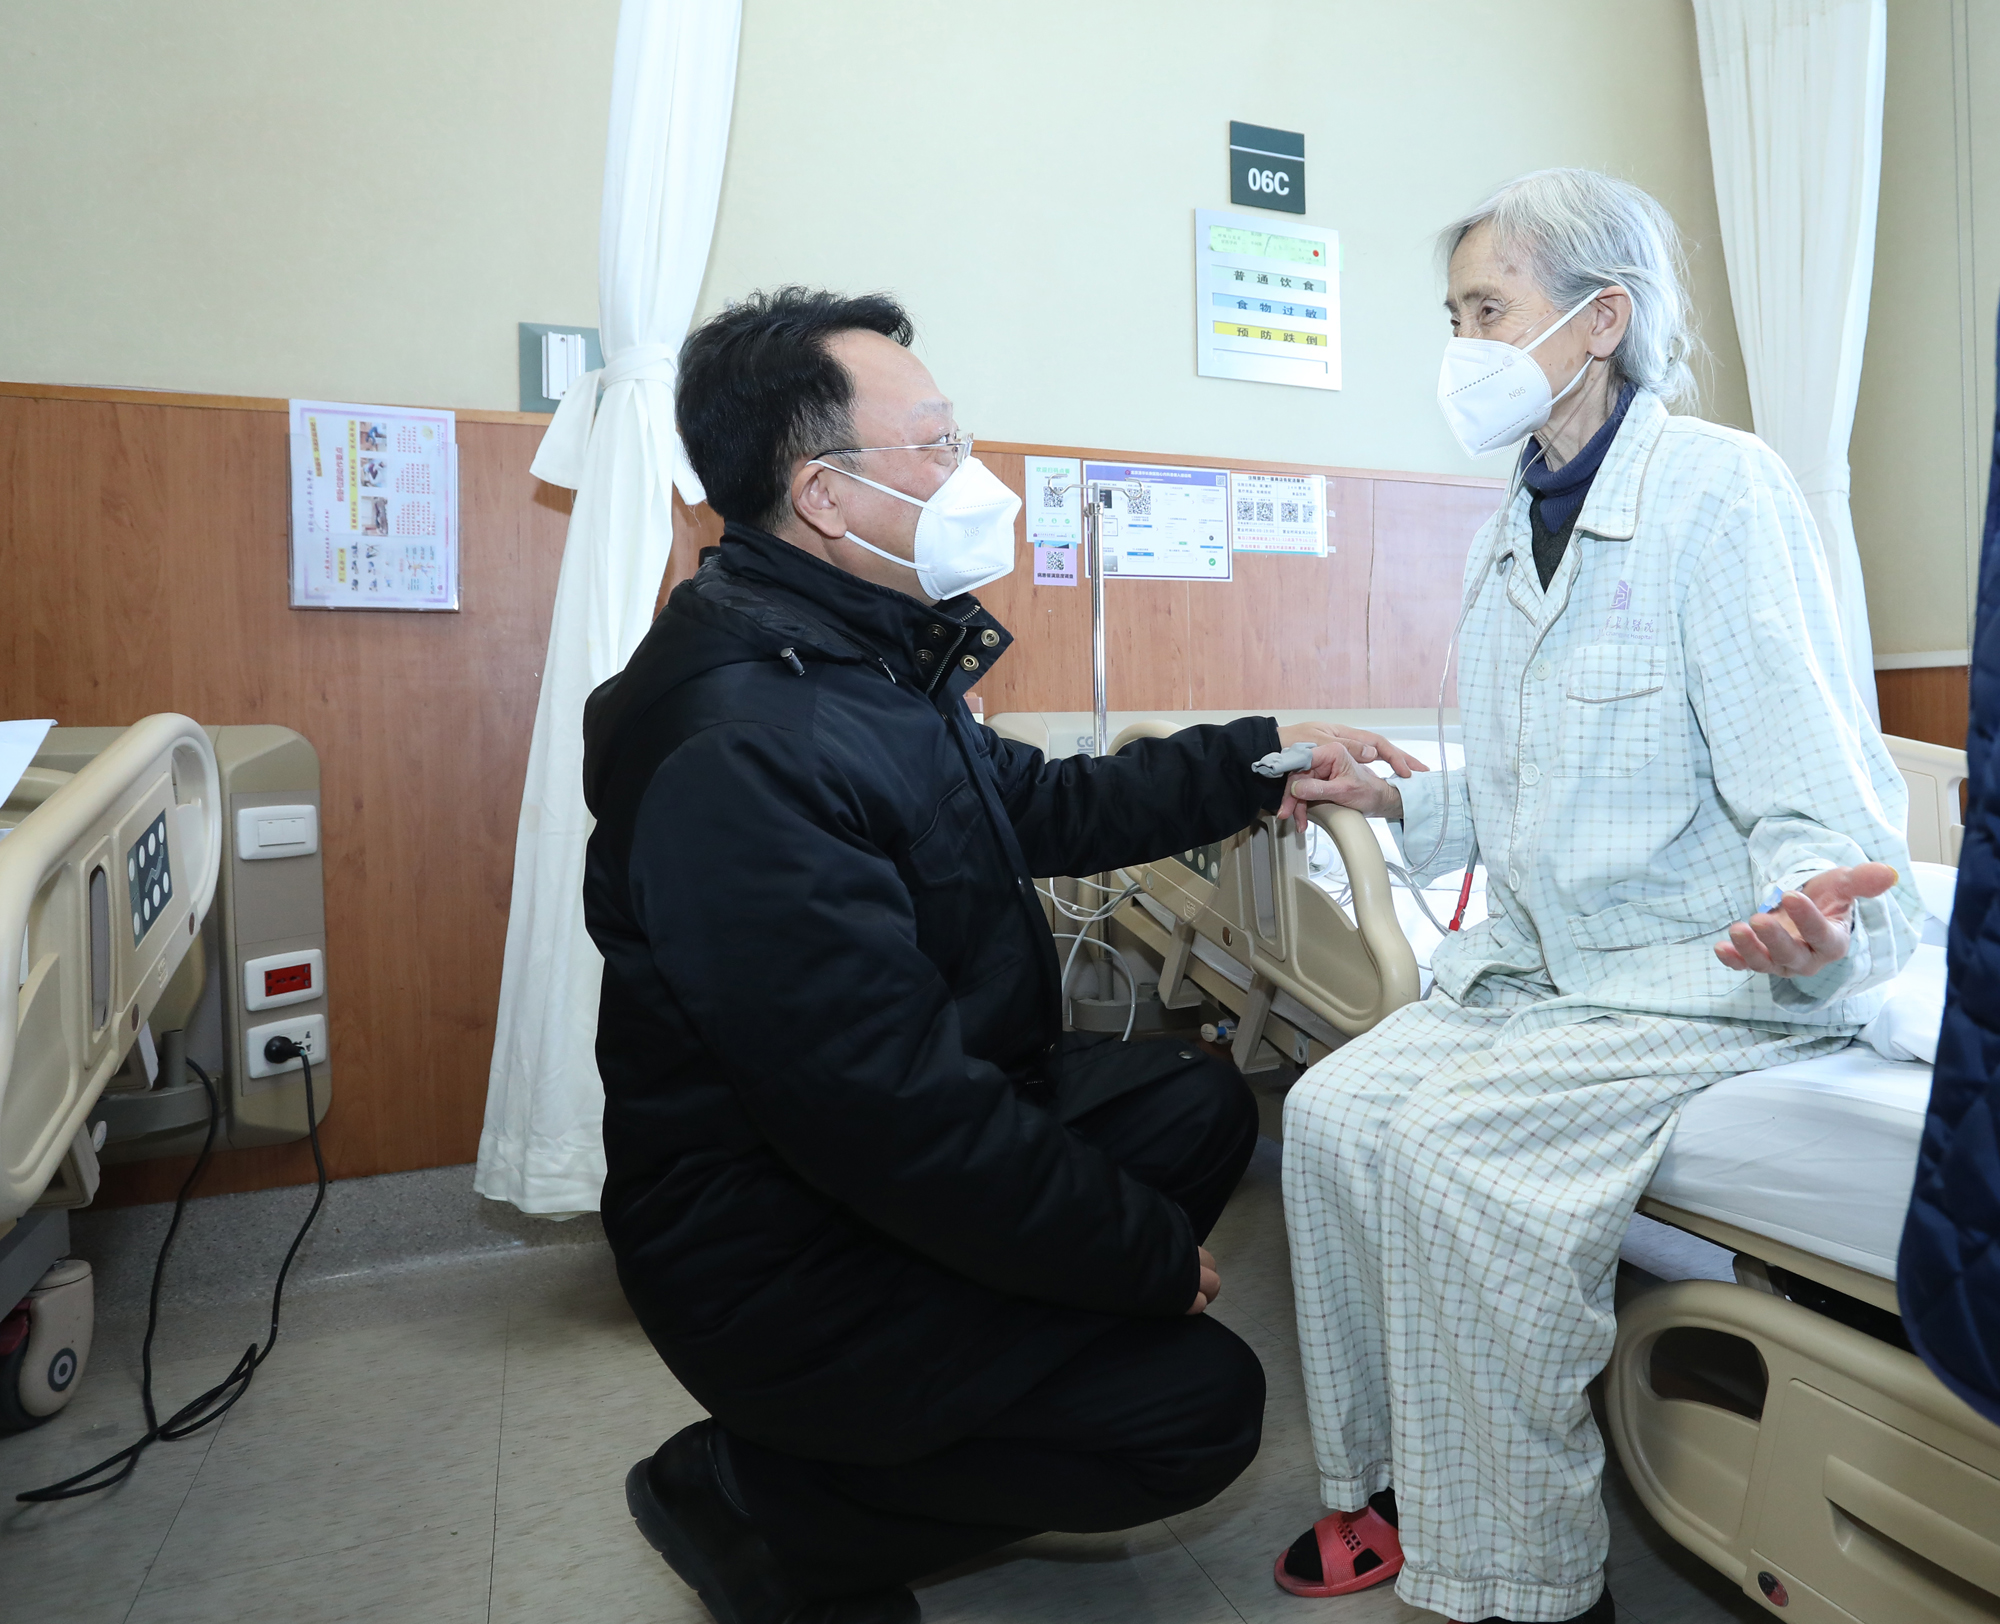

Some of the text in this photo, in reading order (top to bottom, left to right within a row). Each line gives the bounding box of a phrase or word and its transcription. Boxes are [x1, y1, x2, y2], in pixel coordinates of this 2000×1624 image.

[1247, 167, 1290, 196] 06C
[1233, 270, 1315, 292] 普通饮食
[1236, 299, 1318, 320] 食物过敏
[1236, 326, 1318, 347] 预防跌倒
[1508, 386, 1527, 400] N95
[964, 526, 980, 538] N95
